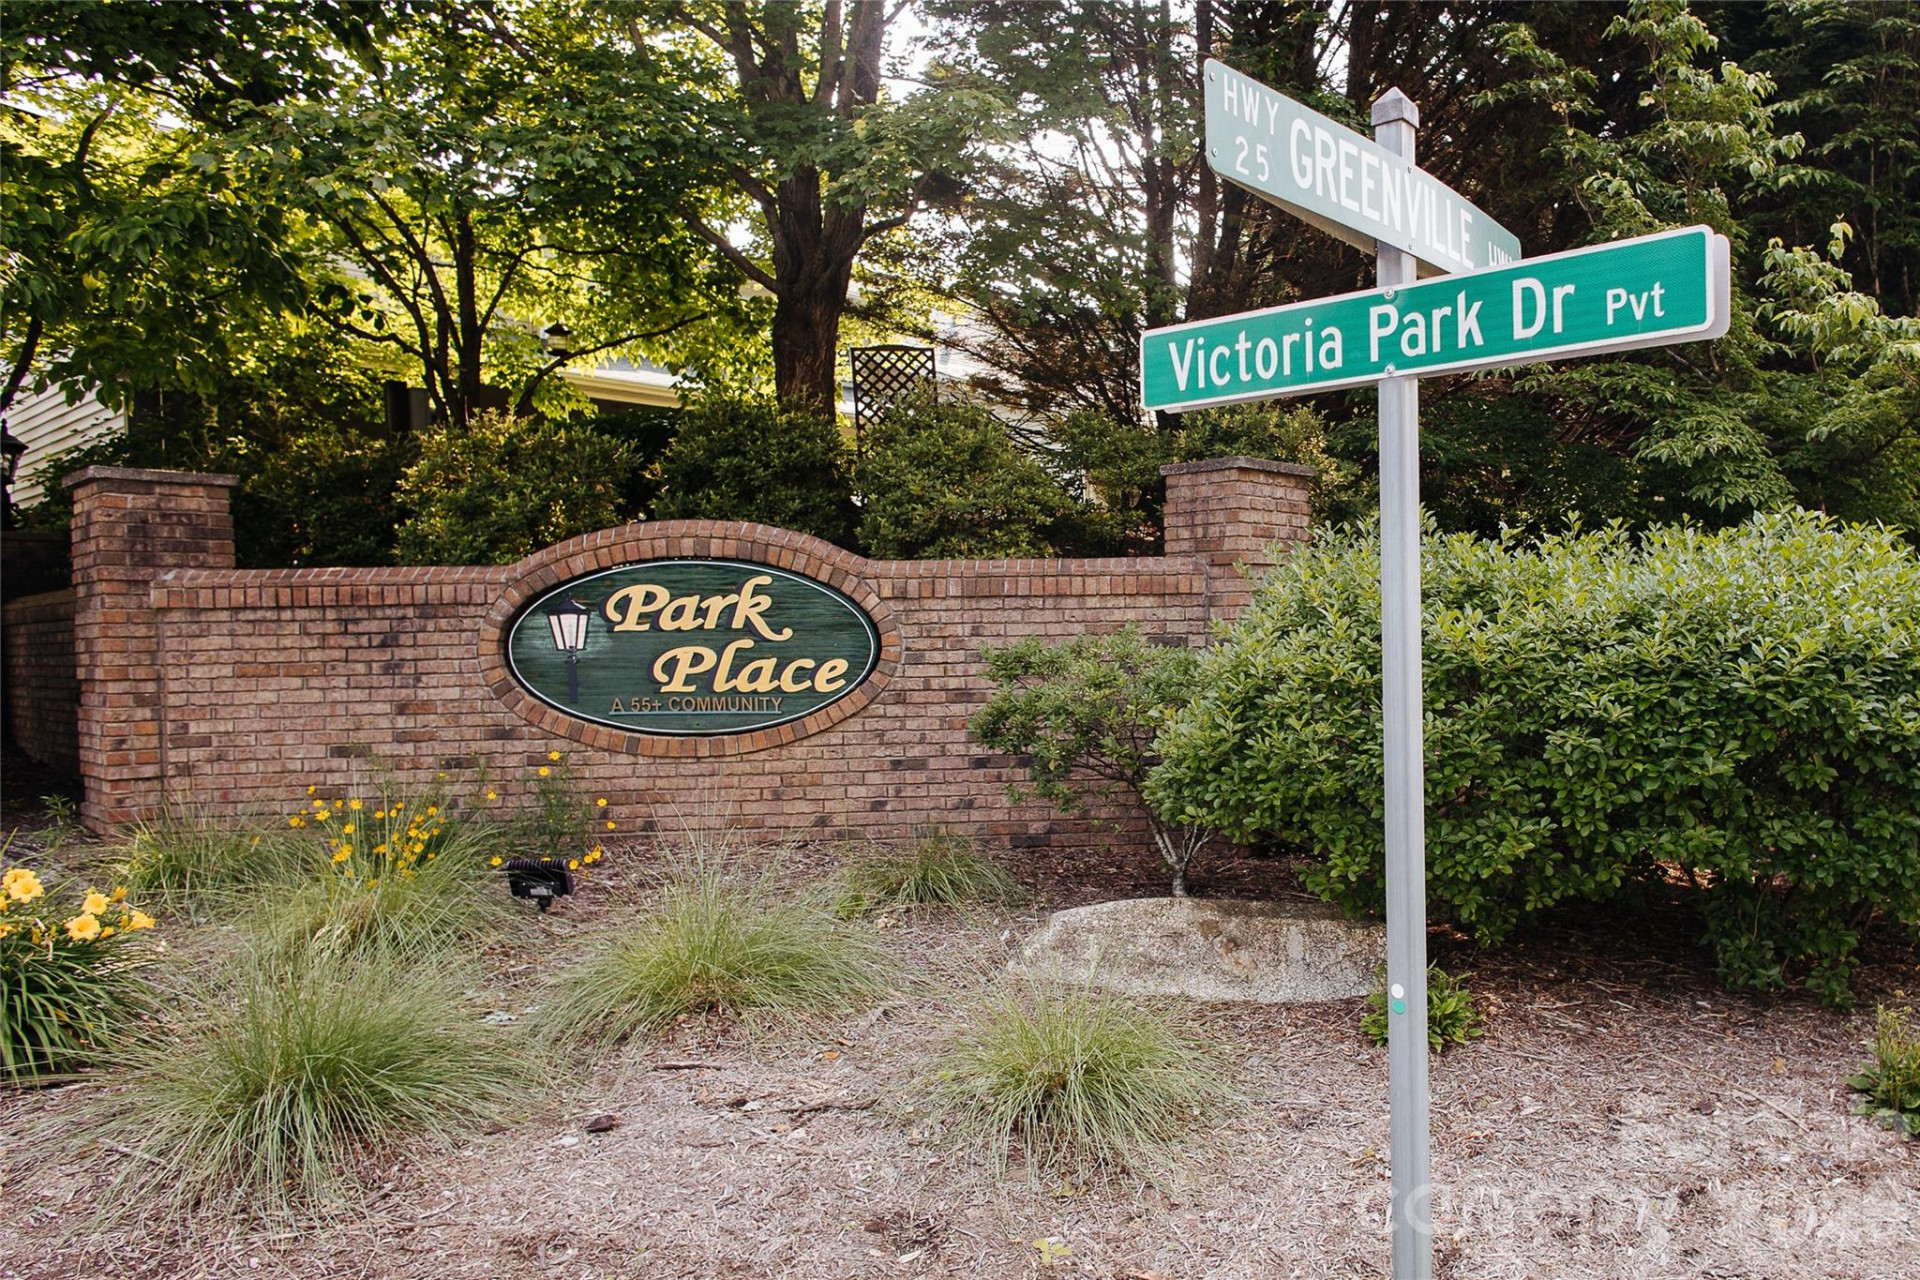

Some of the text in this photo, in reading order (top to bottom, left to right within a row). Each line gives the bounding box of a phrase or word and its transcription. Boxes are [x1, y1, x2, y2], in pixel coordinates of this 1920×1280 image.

[1222, 73, 1280, 136] HWY
[1235, 136, 1270, 183] 25
[1290, 119, 1475, 270] GREENVILLE
[1168, 276, 1666, 392] Victoria Park Dr Pvt
[605, 575, 793, 642] Park
[652, 638, 849, 694] Place
[610, 696, 783, 713] A 55+ COMMUNITY
